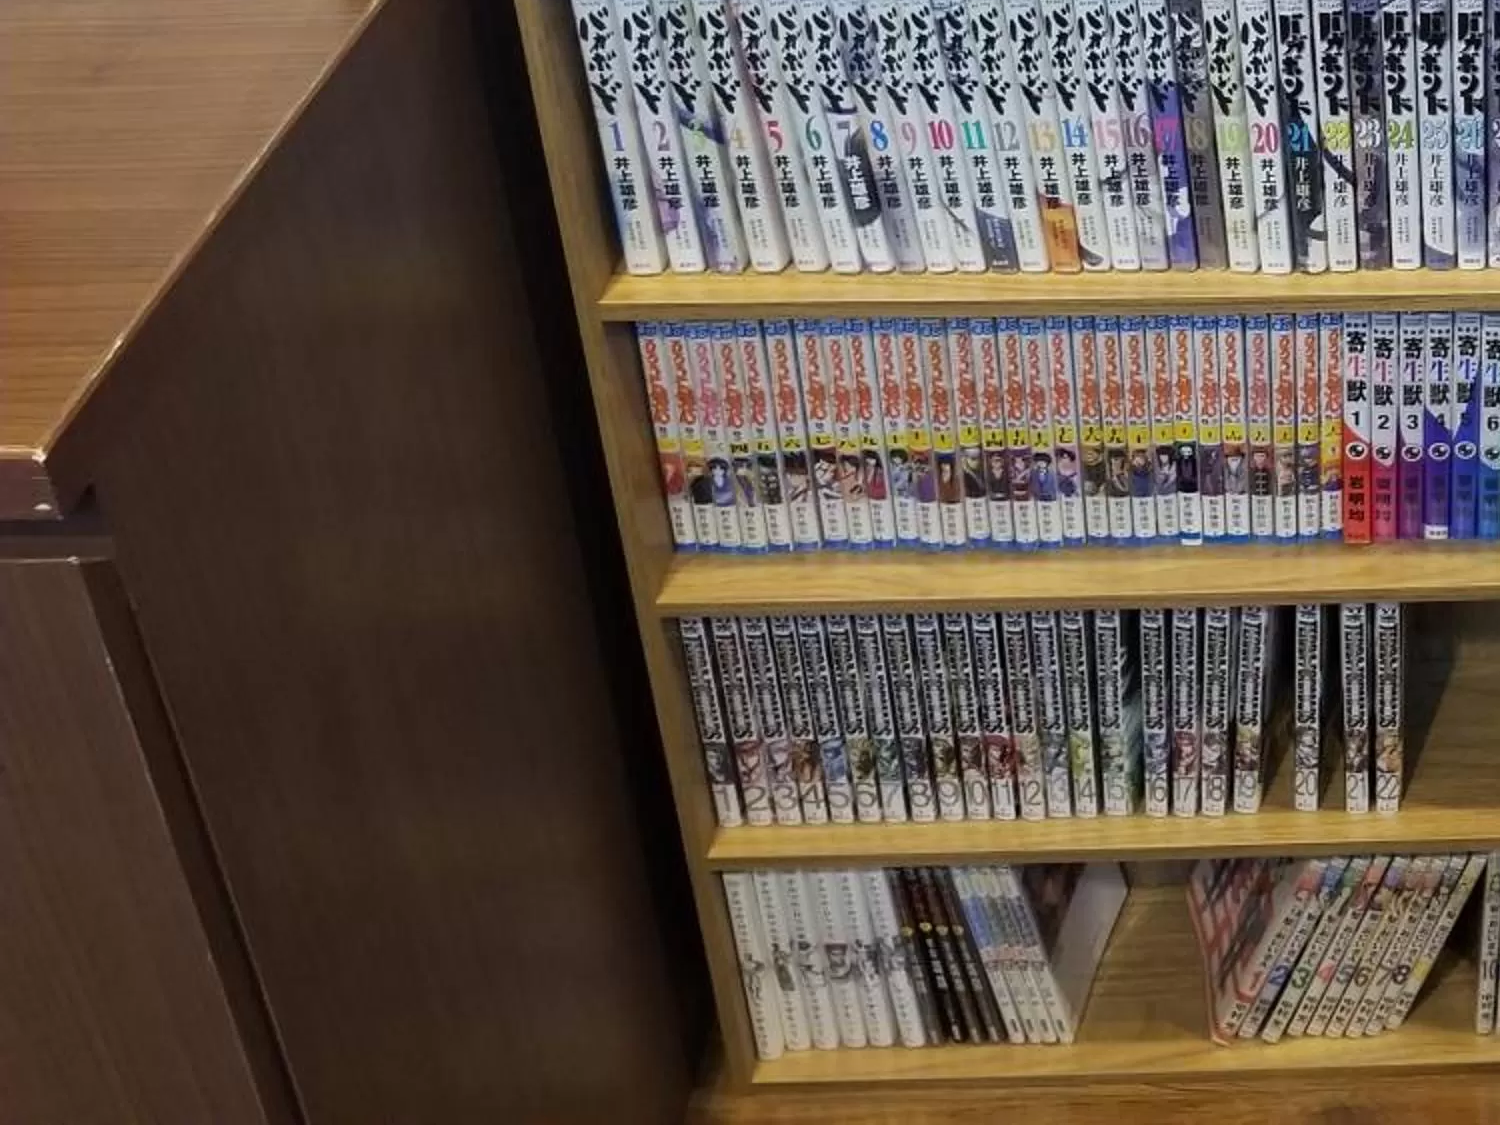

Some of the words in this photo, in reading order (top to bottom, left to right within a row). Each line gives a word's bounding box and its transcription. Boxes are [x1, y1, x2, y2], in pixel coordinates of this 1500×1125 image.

[580, 5, 622, 115] バガボンド
[623, 5, 666, 115] バガボンド
[658, 3, 701, 114] バガボンド
[699, 4, 741, 115] バガボンド
[770, 3, 813, 115] バガボンド
[903, 5, 945, 114] バガボンド
[971, 5, 1011, 115] バガボンド
[652, 121, 671, 152] 2
[766, 121, 784, 154] 5
[805, 115, 823, 152] 6
[870, 120, 889, 152] 8
[928, 121, 955, 150] 10
[961, 122, 988, 150] 11
[1061, 119, 1089, 148] 14
[1251, 122, 1279, 155] 20
[1387, 121, 1414, 151] 24
[614, 156, 640, 211] 井上雄彦
[658, 155, 682, 210] 井上雄彦
[735, 155, 760, 209] 井上雄彦
[775, 155, 801, 209] 井上雄彦
[813, 155, 838, 209] 井上雄彦
[972, 155, 996, 209] 井上雄彦
[1071, 153, 1093, 206] 井上雄彦
[1224, 158, 1245, 210] 井上雄彦
[1346, 330, 1368, 403] 寄生獣
[1373, 338, 1395, 406] 寄生獣
[1402, 338, 1423, 407] 寄生獣
[1377, 414, 1390, 429] 2
[1406, 414, 1419, 429] 3
[1487, 415, 1500, 430] 6
[745, 786, 768, 811] 2
[774, 785, 796, 810] 3
[801, 784, 824, 809] 4
[1268, 965, 1288, 985] 2
[1292, 966, 1312, 989] 3
[1392, 965, 1411, 985] 8
